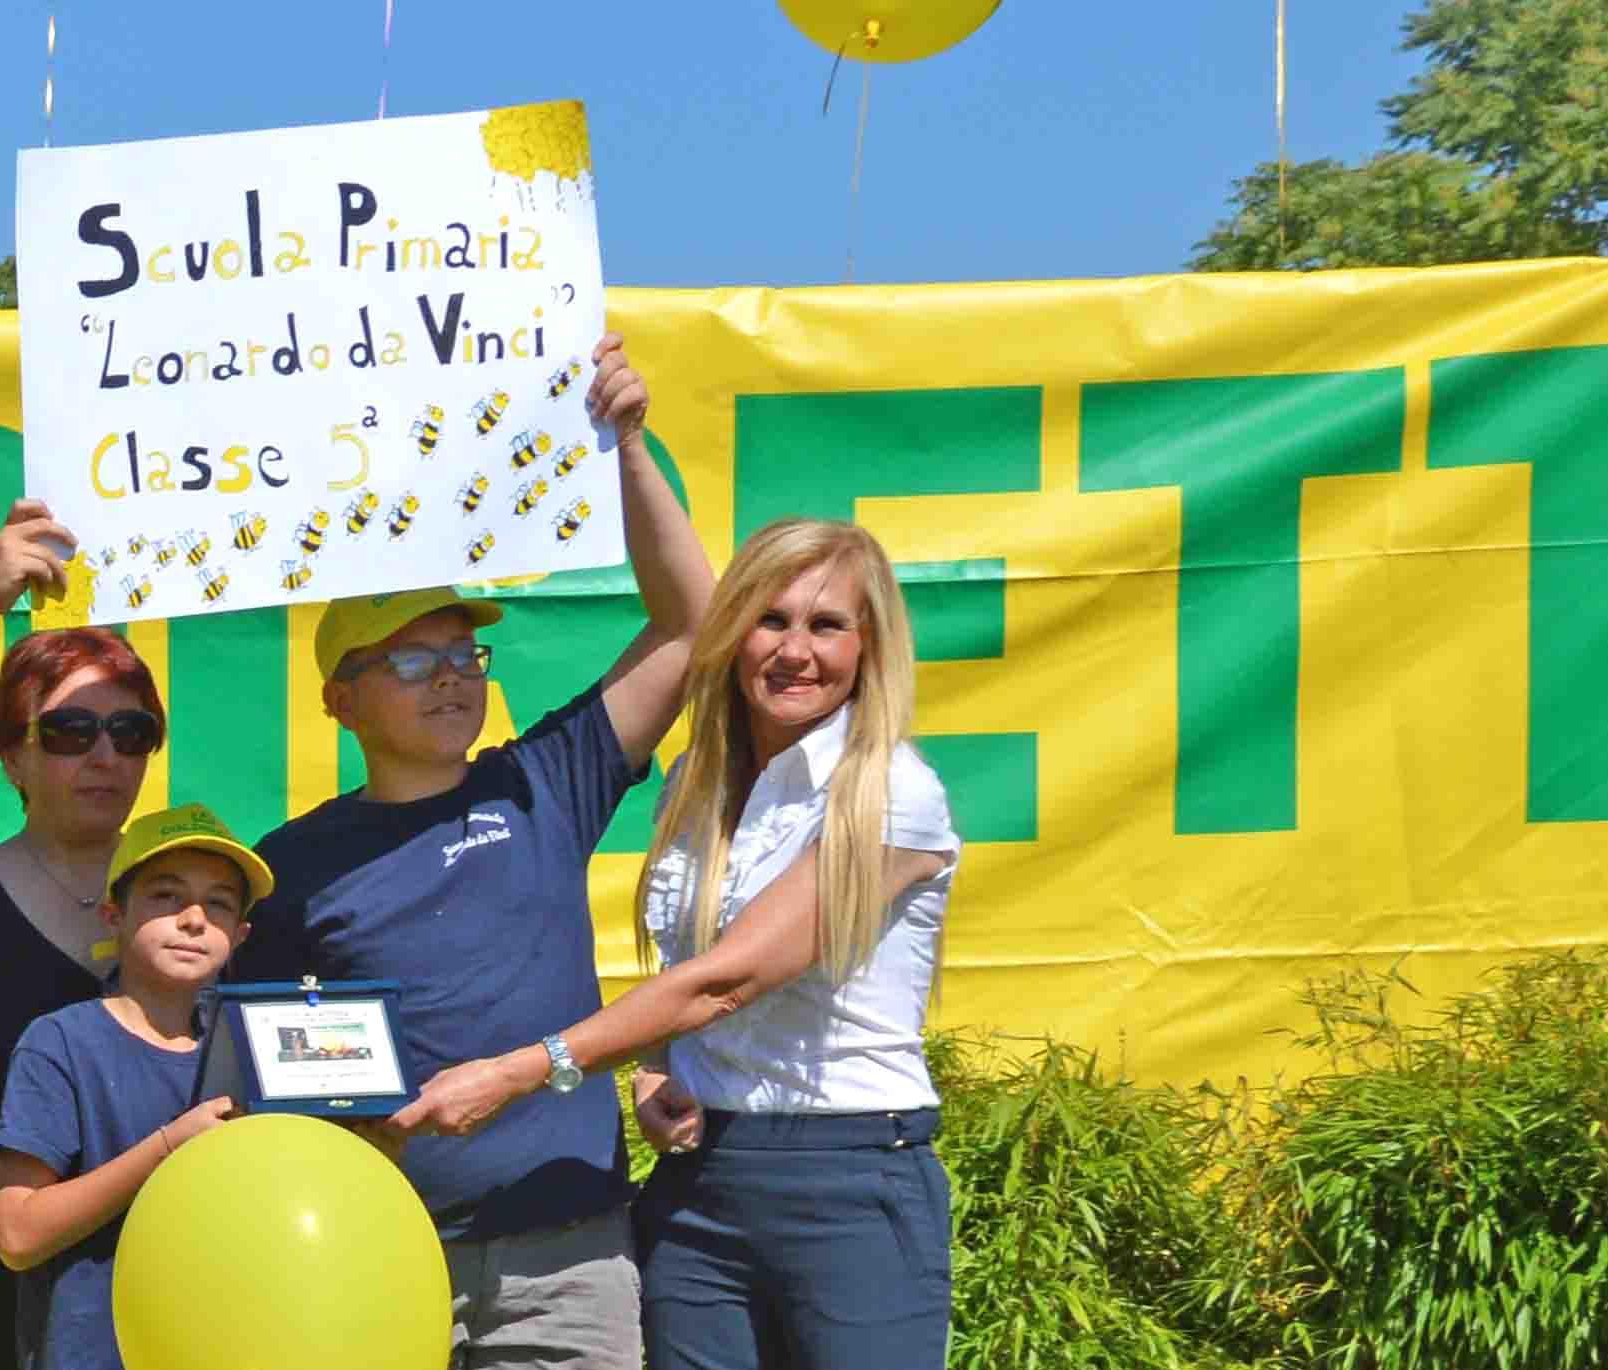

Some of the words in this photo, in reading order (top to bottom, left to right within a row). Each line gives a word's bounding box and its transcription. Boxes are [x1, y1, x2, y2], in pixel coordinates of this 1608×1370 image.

[78, 188, 311, 298] Scuola
[338, 182, 543, 272] Primaria
[348, 305, 407, 368] da
[91, 430, 289, 498] Classe
